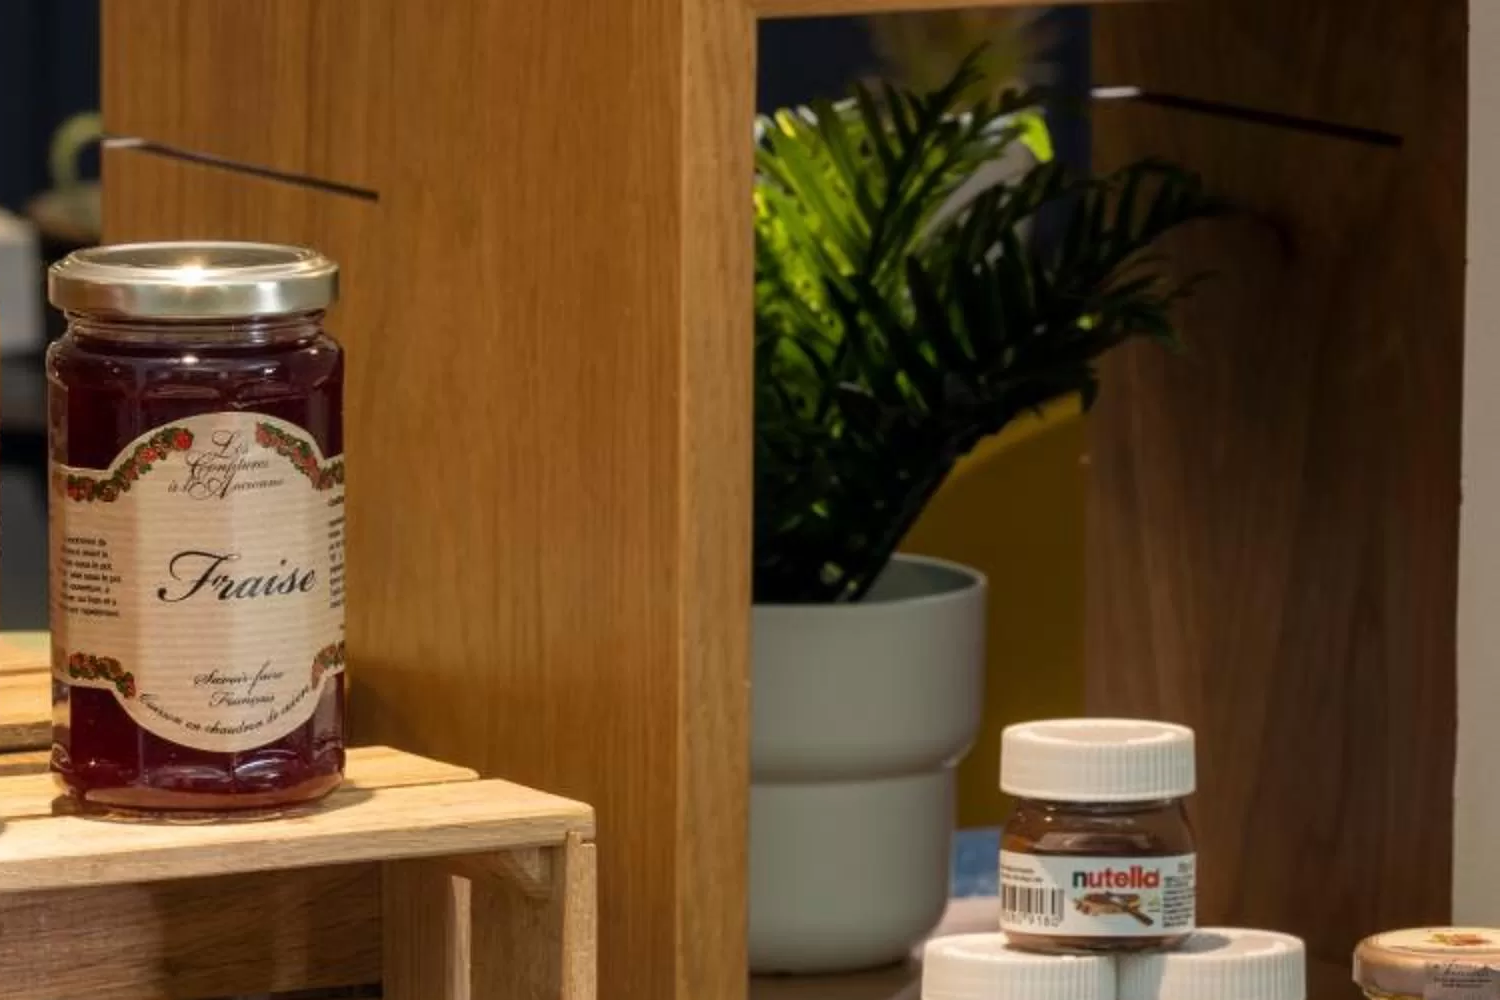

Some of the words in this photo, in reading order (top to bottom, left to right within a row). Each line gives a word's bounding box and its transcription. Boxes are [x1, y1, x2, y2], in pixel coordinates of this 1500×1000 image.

[157, 550, 316, 602] Fraise
[185, 722, 201, 732] en
[1072, 865, 1160, 889] nutella
